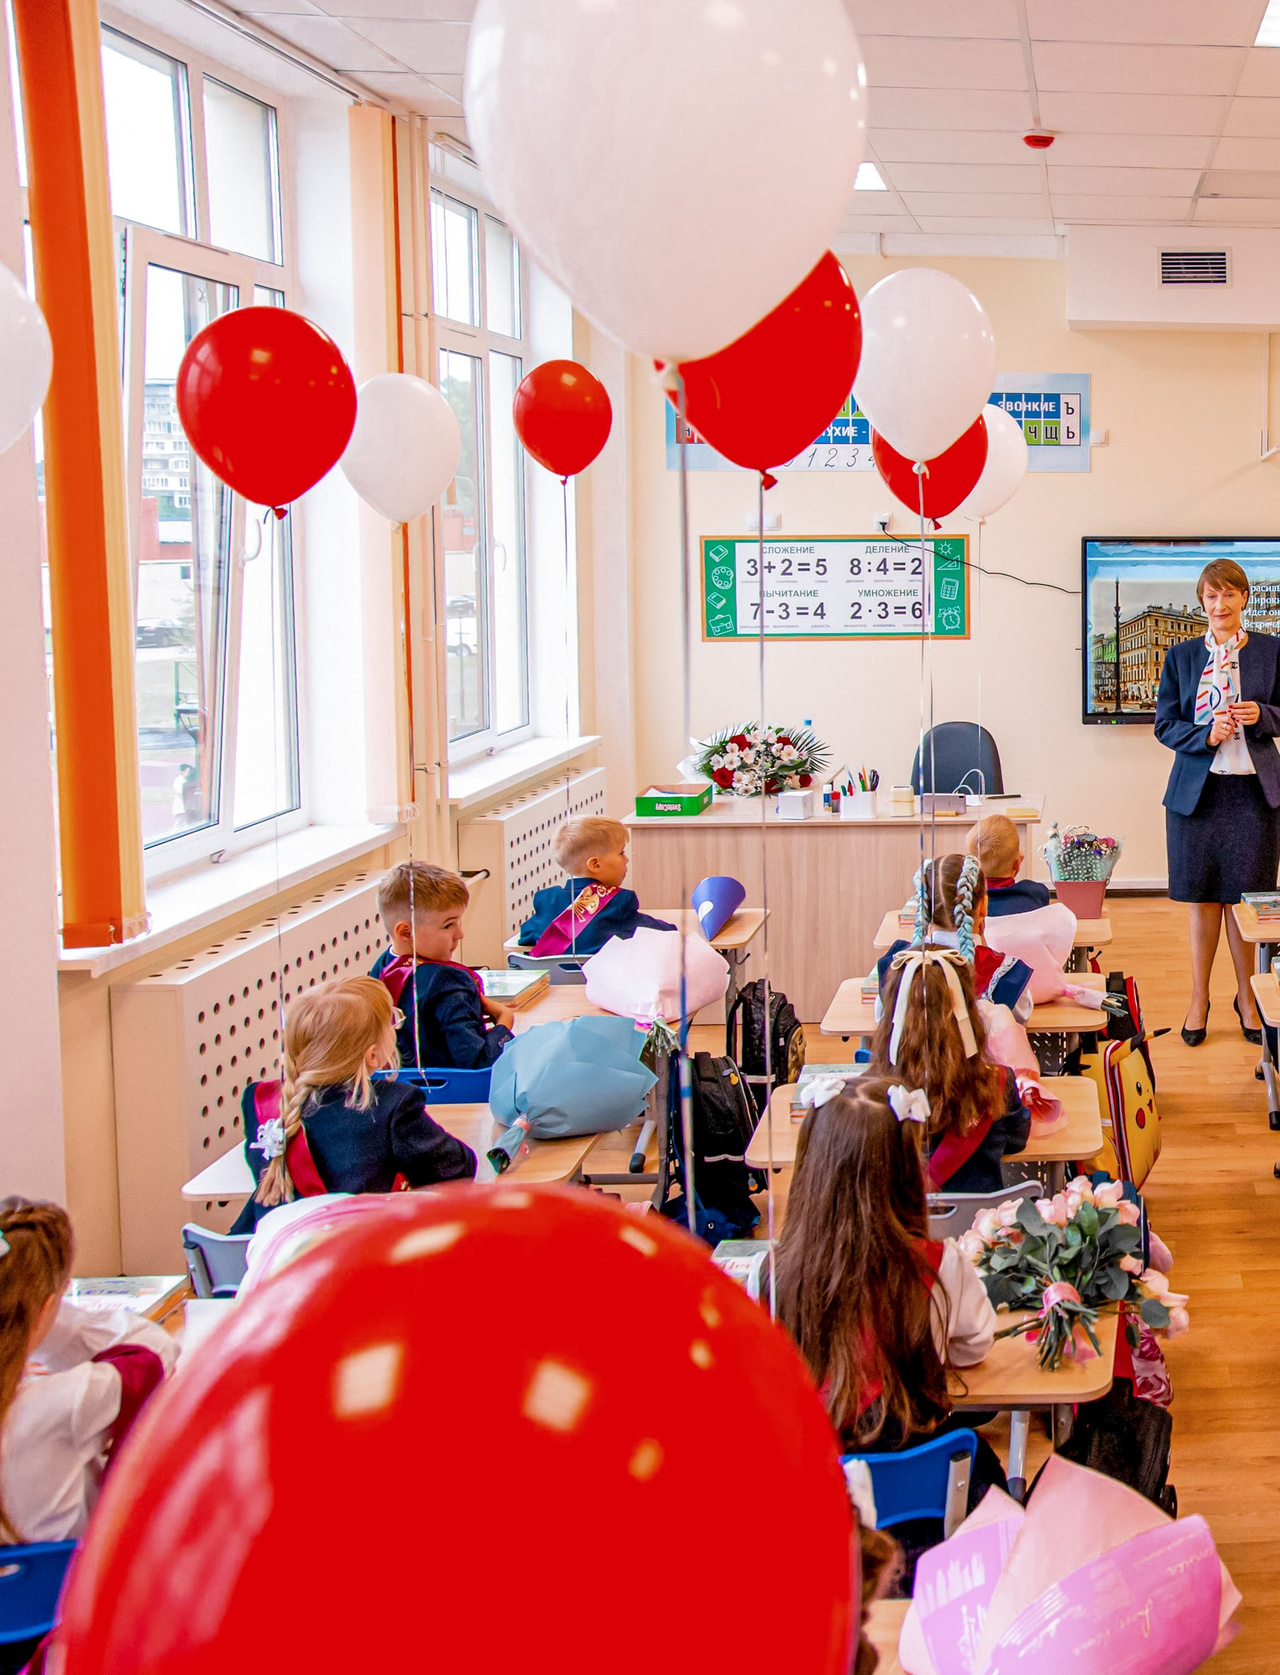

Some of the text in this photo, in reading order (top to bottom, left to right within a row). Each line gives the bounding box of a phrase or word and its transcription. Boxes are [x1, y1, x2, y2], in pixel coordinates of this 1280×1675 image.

[998, 401, 1075, 415] ЗВОНКИЕ Ъ
[1028, 426, 1075, 441] Ч Щ Ь
[808, 448, 818, 467] 1
[825, 448, 838, 467] 2
[846, 448, 859, 467] 3
[762, 546, 816, 554] СЛОЖЕНИЕ
[865, 546, 910, 554] ДЕЛЕНИЕ
